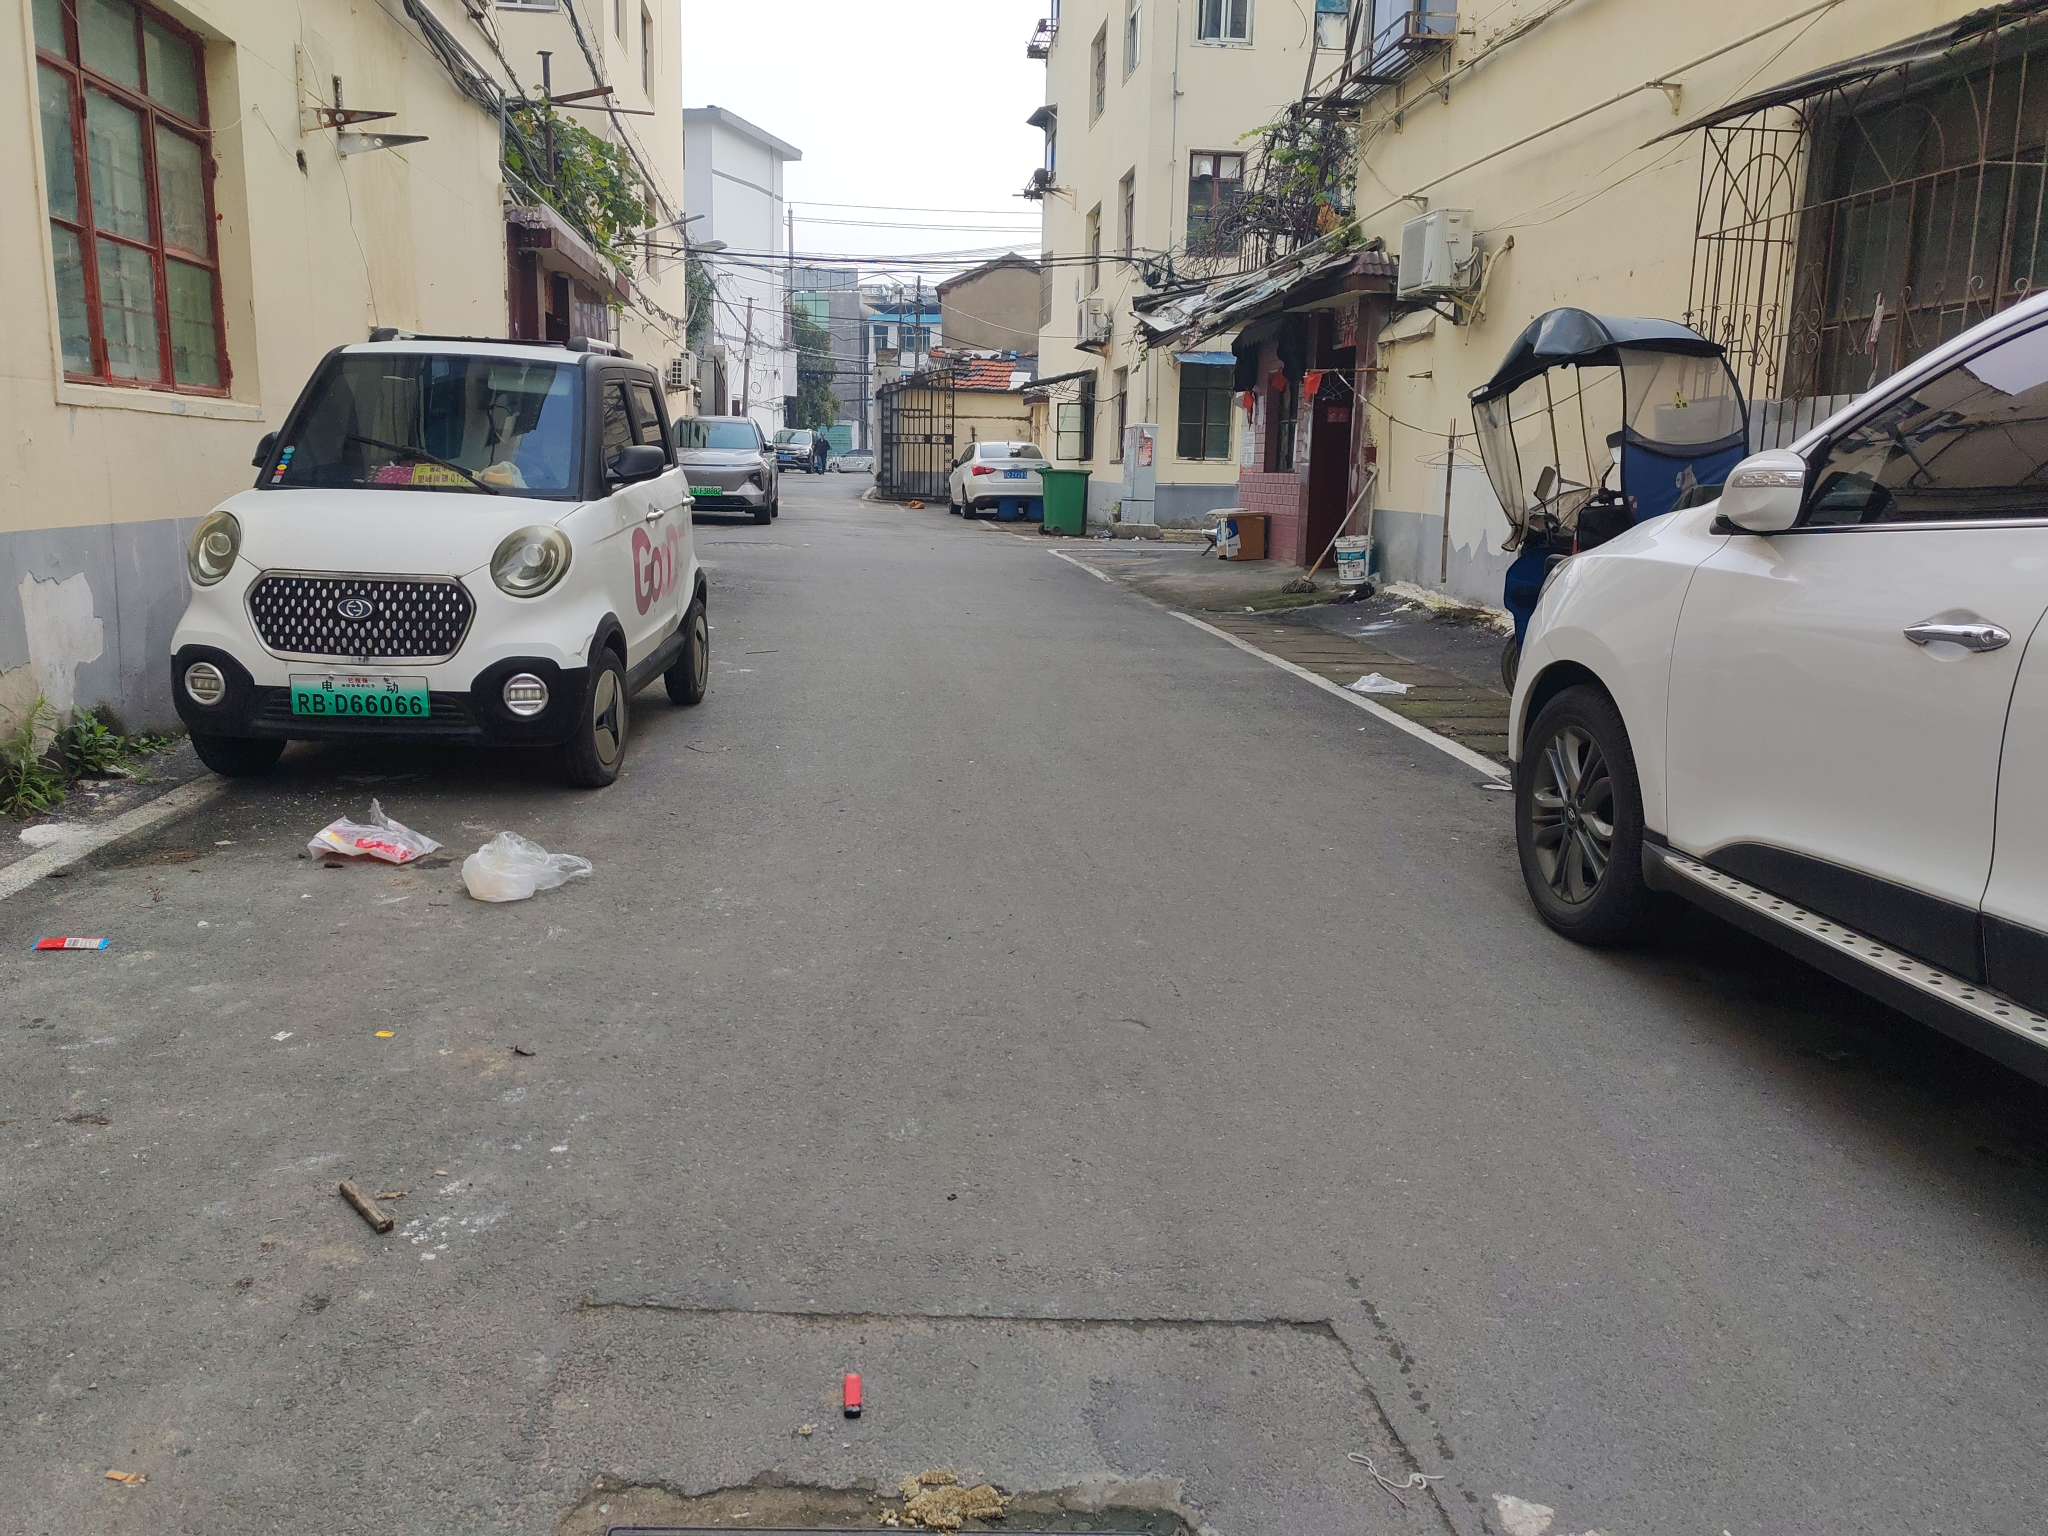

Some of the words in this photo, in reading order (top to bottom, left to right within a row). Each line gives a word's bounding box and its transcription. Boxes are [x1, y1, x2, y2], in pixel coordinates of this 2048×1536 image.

[321, 679, 335, 693] 电
[385, 681, 399, 694] 动
[297, 693, 423, 715] RB·D66066
